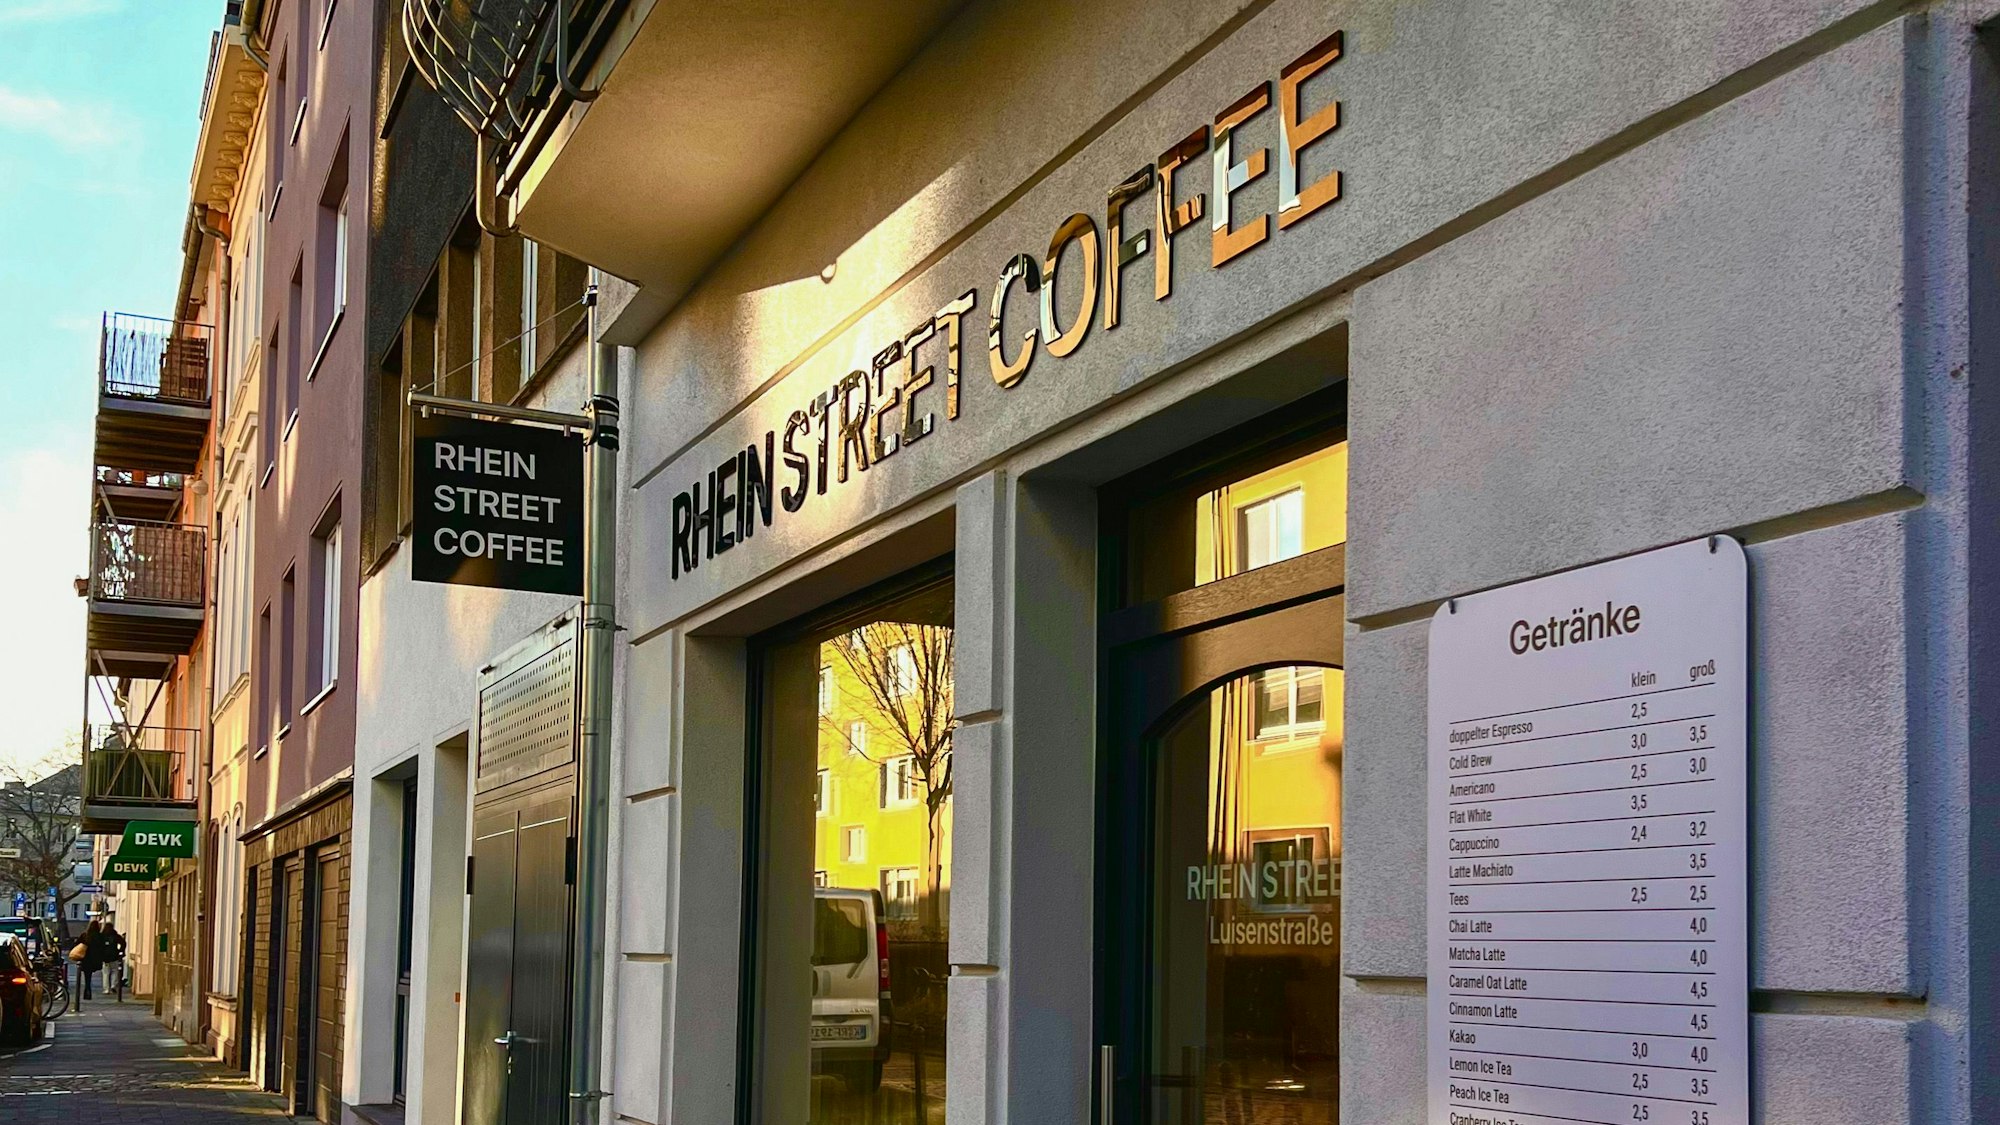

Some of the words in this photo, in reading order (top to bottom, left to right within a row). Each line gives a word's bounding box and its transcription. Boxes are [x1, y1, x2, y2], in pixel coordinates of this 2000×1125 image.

[671, 431, 774, 580] RHEIN
[781, 288, 977, 513] STREET
[988, 29, 1344, 389] COFFEE
[434, 442, 536, 480] RHEIN
[433, 484, 561, 524] STREET
[433, 527, 564, 566] COFFEE
[1509, 601, 1640, 655] Getränke
[1631, 671, 1656, 688] klein
[1689, 659, 1716, 682] groß
[1449, 726, 1490, 745] doppelter
[1491, 722, 1533, 739] Espresso
[1631, 702, 1647, 719] 2,5
[1449, 755, 1469, 770] Cold
[1470, 754, 1492, 768] Brew
[1631, 732, 1647, 750] 3,0
[1689, 724, 1707, 743] 3,5
[1449, 782, 1495, 797] Americano
[1631, 763, 1647, 780] 2,5
[1689, 756, 1706, 775] 3,0
[1449, 810, 1466, 824] Flat
[1467, 808, 1492, 822] White
[1631, 794, 1647, 811] 3,5
[135, 832, 183, 847] DEVK
[1449, 836, 1500, 854] Cappuccino
[1631, 825, 1647, 842] 2,4
[1689, 821, 1707, 839] 3,2
[114, 863, 149, 873] DEVK
[1187, 862, 1257, 901] RHEIN
[1449, 865, 1471, 879] Latte
[1472, 862, 1514, 878] Machiato
[1689, 853, 1707, 871] 3,5
[1448, 892, 1469, 906] Tees
[1631, 887, 1647, 904] 2,5
[1689, 885, 1707, 903] 2,5
[1210, 914, 1333, 946] Luisenstraße
[1448, 919, 1468, 933] Chai
[1470, 919, 1492, 933] Latte
[1689, 917, 1707, 935] 4,0
[1449, 947, 1481, 961] Matcha
[1482, 947, 1506, 961] Latte
[1689, 949, 1707, 967] 4,0
[1449, 974, 1485, 989] Caramel
[1486, 975, 1502, 989] Oat
[1504, 976, 1527, 991] Latte
[1690, 981, 1707, 1000] 4,5
[1449, 1001, 1492, 1017] Cinnamon
[1494, 1004, 1518, 1019] Latte
[1690, 1013, 1708, 1032] 4,5
[1449, 1029, 1476, 1044] Kakao
[1632, 1042, 1648, 1059] 3,0
[1691, 1046, 1708, 1064] 4,0
[1449, 1056, 1479, 1072] Lemon
[1480, 1060, 1494, 1074] Ice
[1496, 1061, 1512, 1075] Tea
[1632, 1073, 1649, 1091] 2,5
[1691, 1078, 1708, 1097] 3,5
[1449, 1084, 1476, 1100] Peach
[1478, 1087, 1491, 1102] Ice
[1493, 1089, 1509, 1104] Tea
[1632, 1104, 1649, 1122] 2,5
